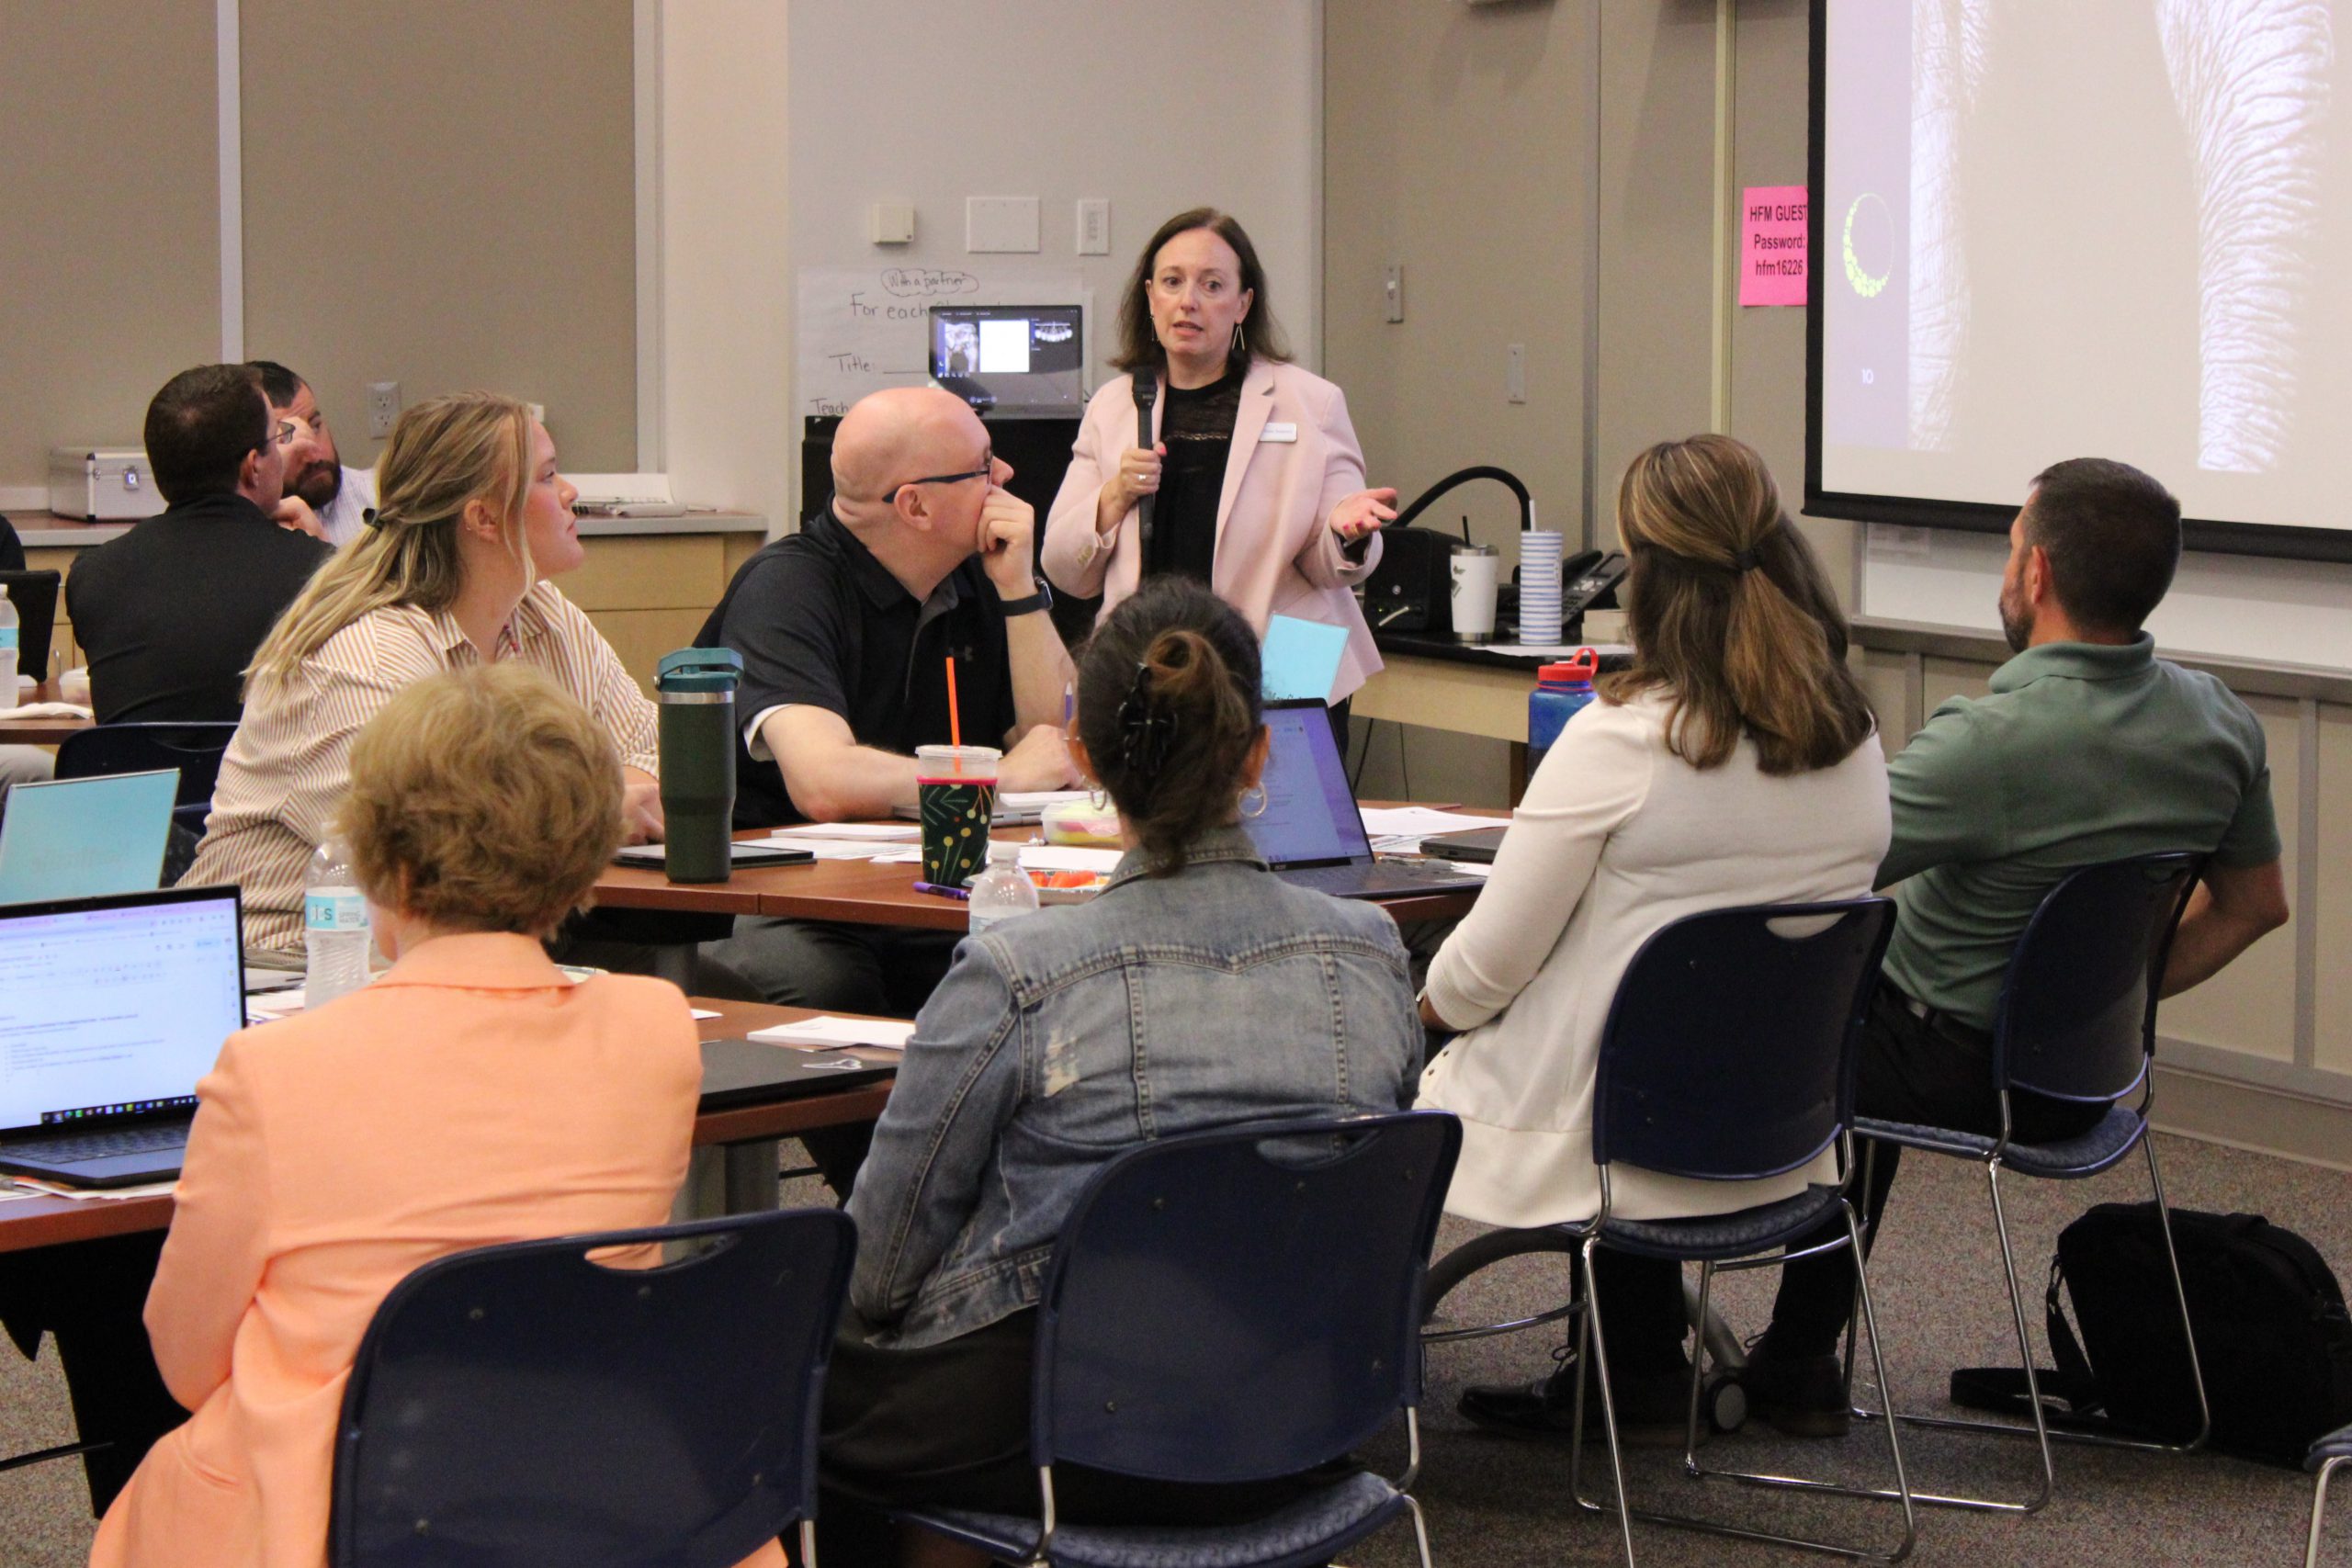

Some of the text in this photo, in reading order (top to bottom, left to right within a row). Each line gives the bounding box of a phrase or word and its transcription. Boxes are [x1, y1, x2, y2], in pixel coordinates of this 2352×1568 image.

[1749, 205, 1808, 221] HFM GUEST
[1754, 233, 1805, 249] Password:
[1756, 260, 1803, 276] hfm16226
[850, 291, 928, 319] For each
[1861, 368, 1874, 384] 10
